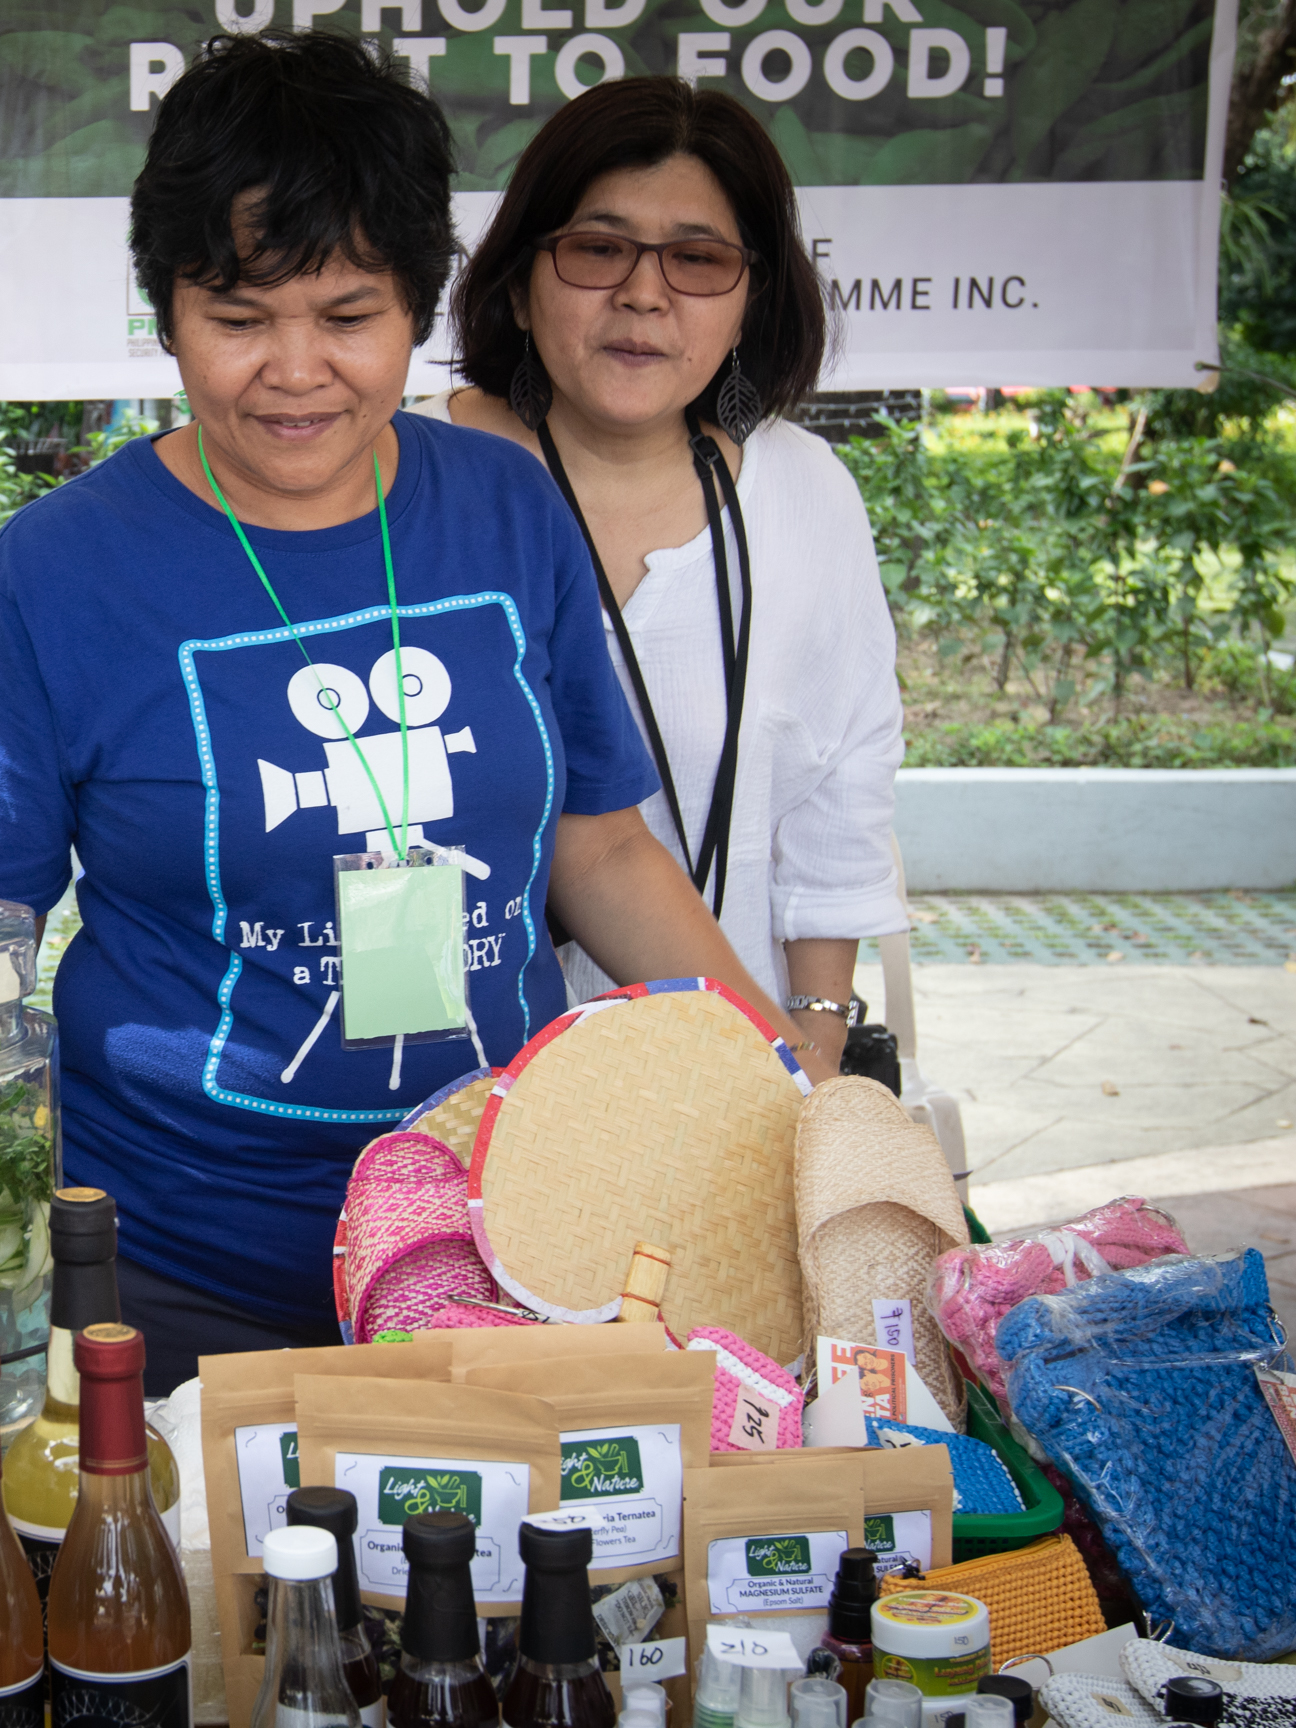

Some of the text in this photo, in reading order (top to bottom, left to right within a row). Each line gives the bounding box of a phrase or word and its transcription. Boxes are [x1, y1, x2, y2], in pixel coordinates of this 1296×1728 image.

[494, 33, 625, 105] TO
[677, 27, 1007, 102] FOOD!
[952, 276, 1039, 310] INC.
[239, 921, 285, 951] My
[293, 966, 311, 985] a
[561, 1452, 589, 1475] ight
[383, 1476, 426, 1500] Light
[591, 1475, 640, 1493] Nature
[617, 1511, 656, 1522] Ternatea
[623, 1535, 636, 1544] Tea
[748, 1545, 775, 1561] Light
[776, 1560, 808, 1573] Nature
[739, 1586, 823, 1598] MAGNESIUM SULFATE
[748, 1579, 777, 1590] Organic
[785, 1577, 814, 1586] Natural
[763, 1596, 804, 1607] (Epsom Salt)
[721, 1639, 768, 1655] 210
[629, 1647, 664, 1667] 160
